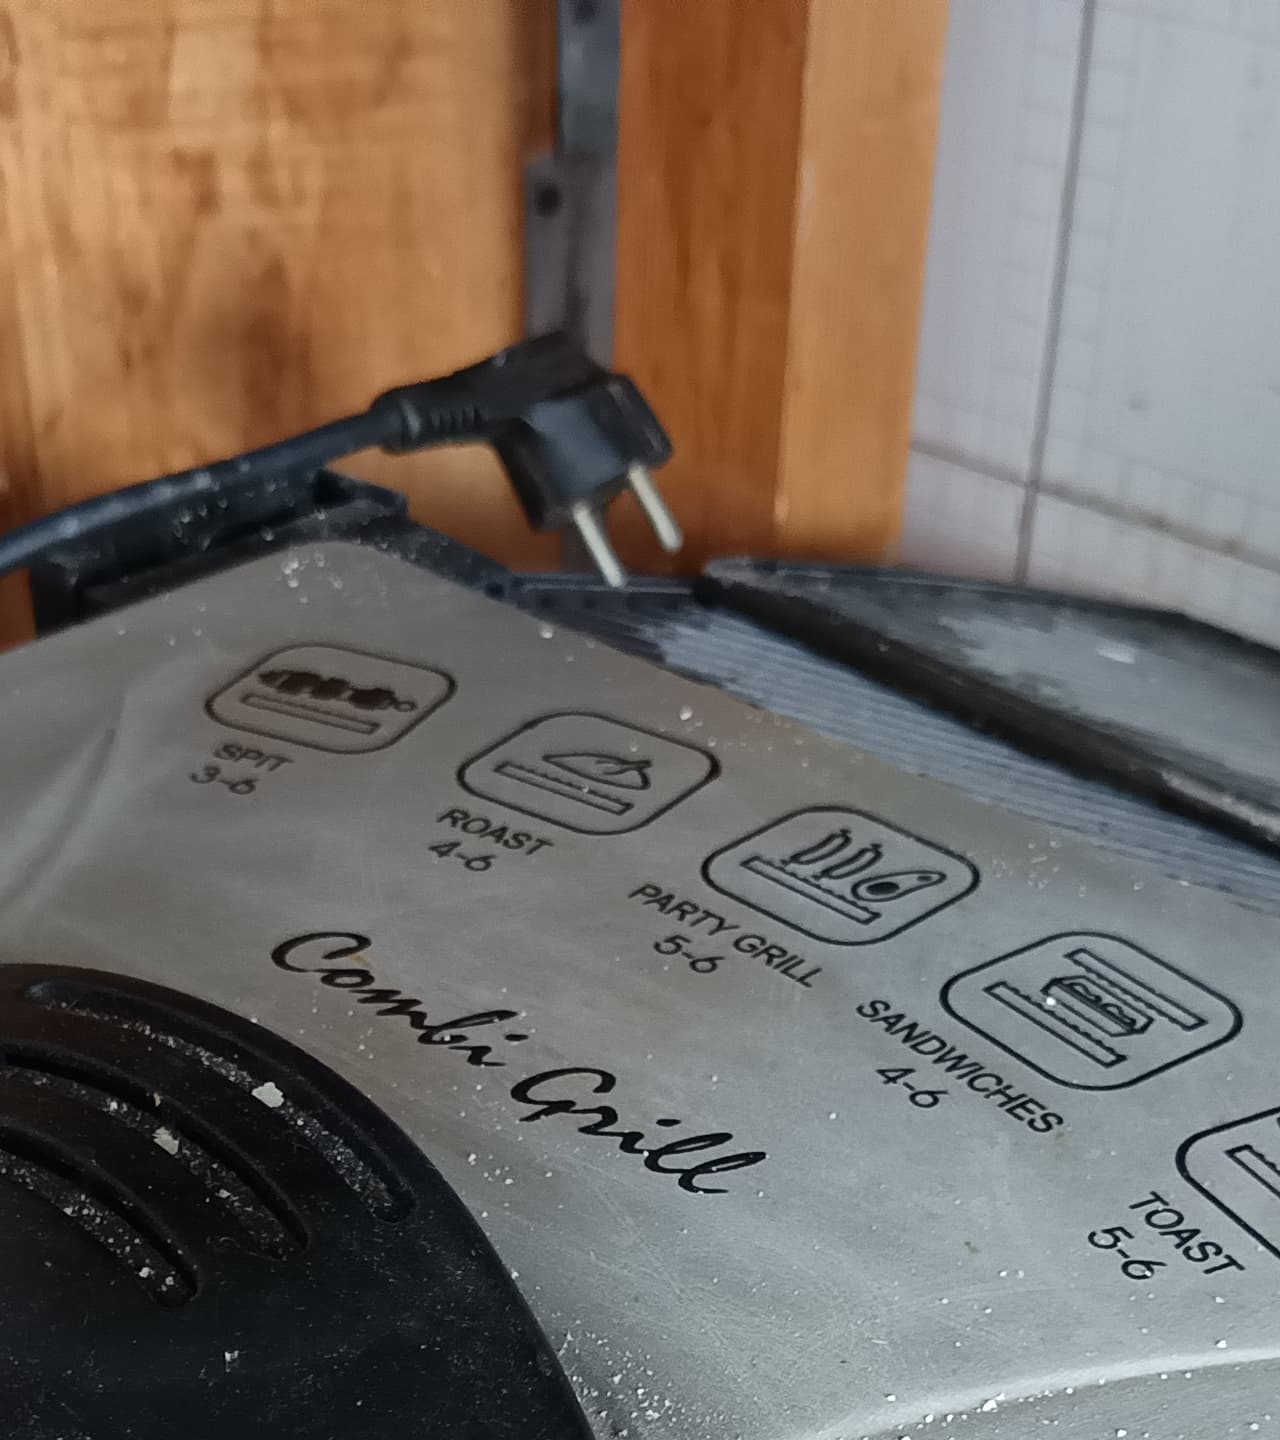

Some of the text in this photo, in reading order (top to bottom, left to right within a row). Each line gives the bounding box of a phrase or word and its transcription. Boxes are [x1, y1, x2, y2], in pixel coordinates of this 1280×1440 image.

[189, 764, 257, 796] 3-6
[213, 743, 296, 772] SPIT
[436, 807, 555, 856] ROAST
[428, 840, 493, 873] 4-6
[628, 882, 823, 988] PARTY GRILL
[653, 933, 724, 975] 5-6
[271, 931, 767, 1194] Combi Grill
[855, 998, 1065, 1134] SANDWICHES
[875, 1065, 944, 1111] 4-6
[1087, 1226, 1167, 1281] 5-6
[1128, 1190, 1246, 1277] TOAST
